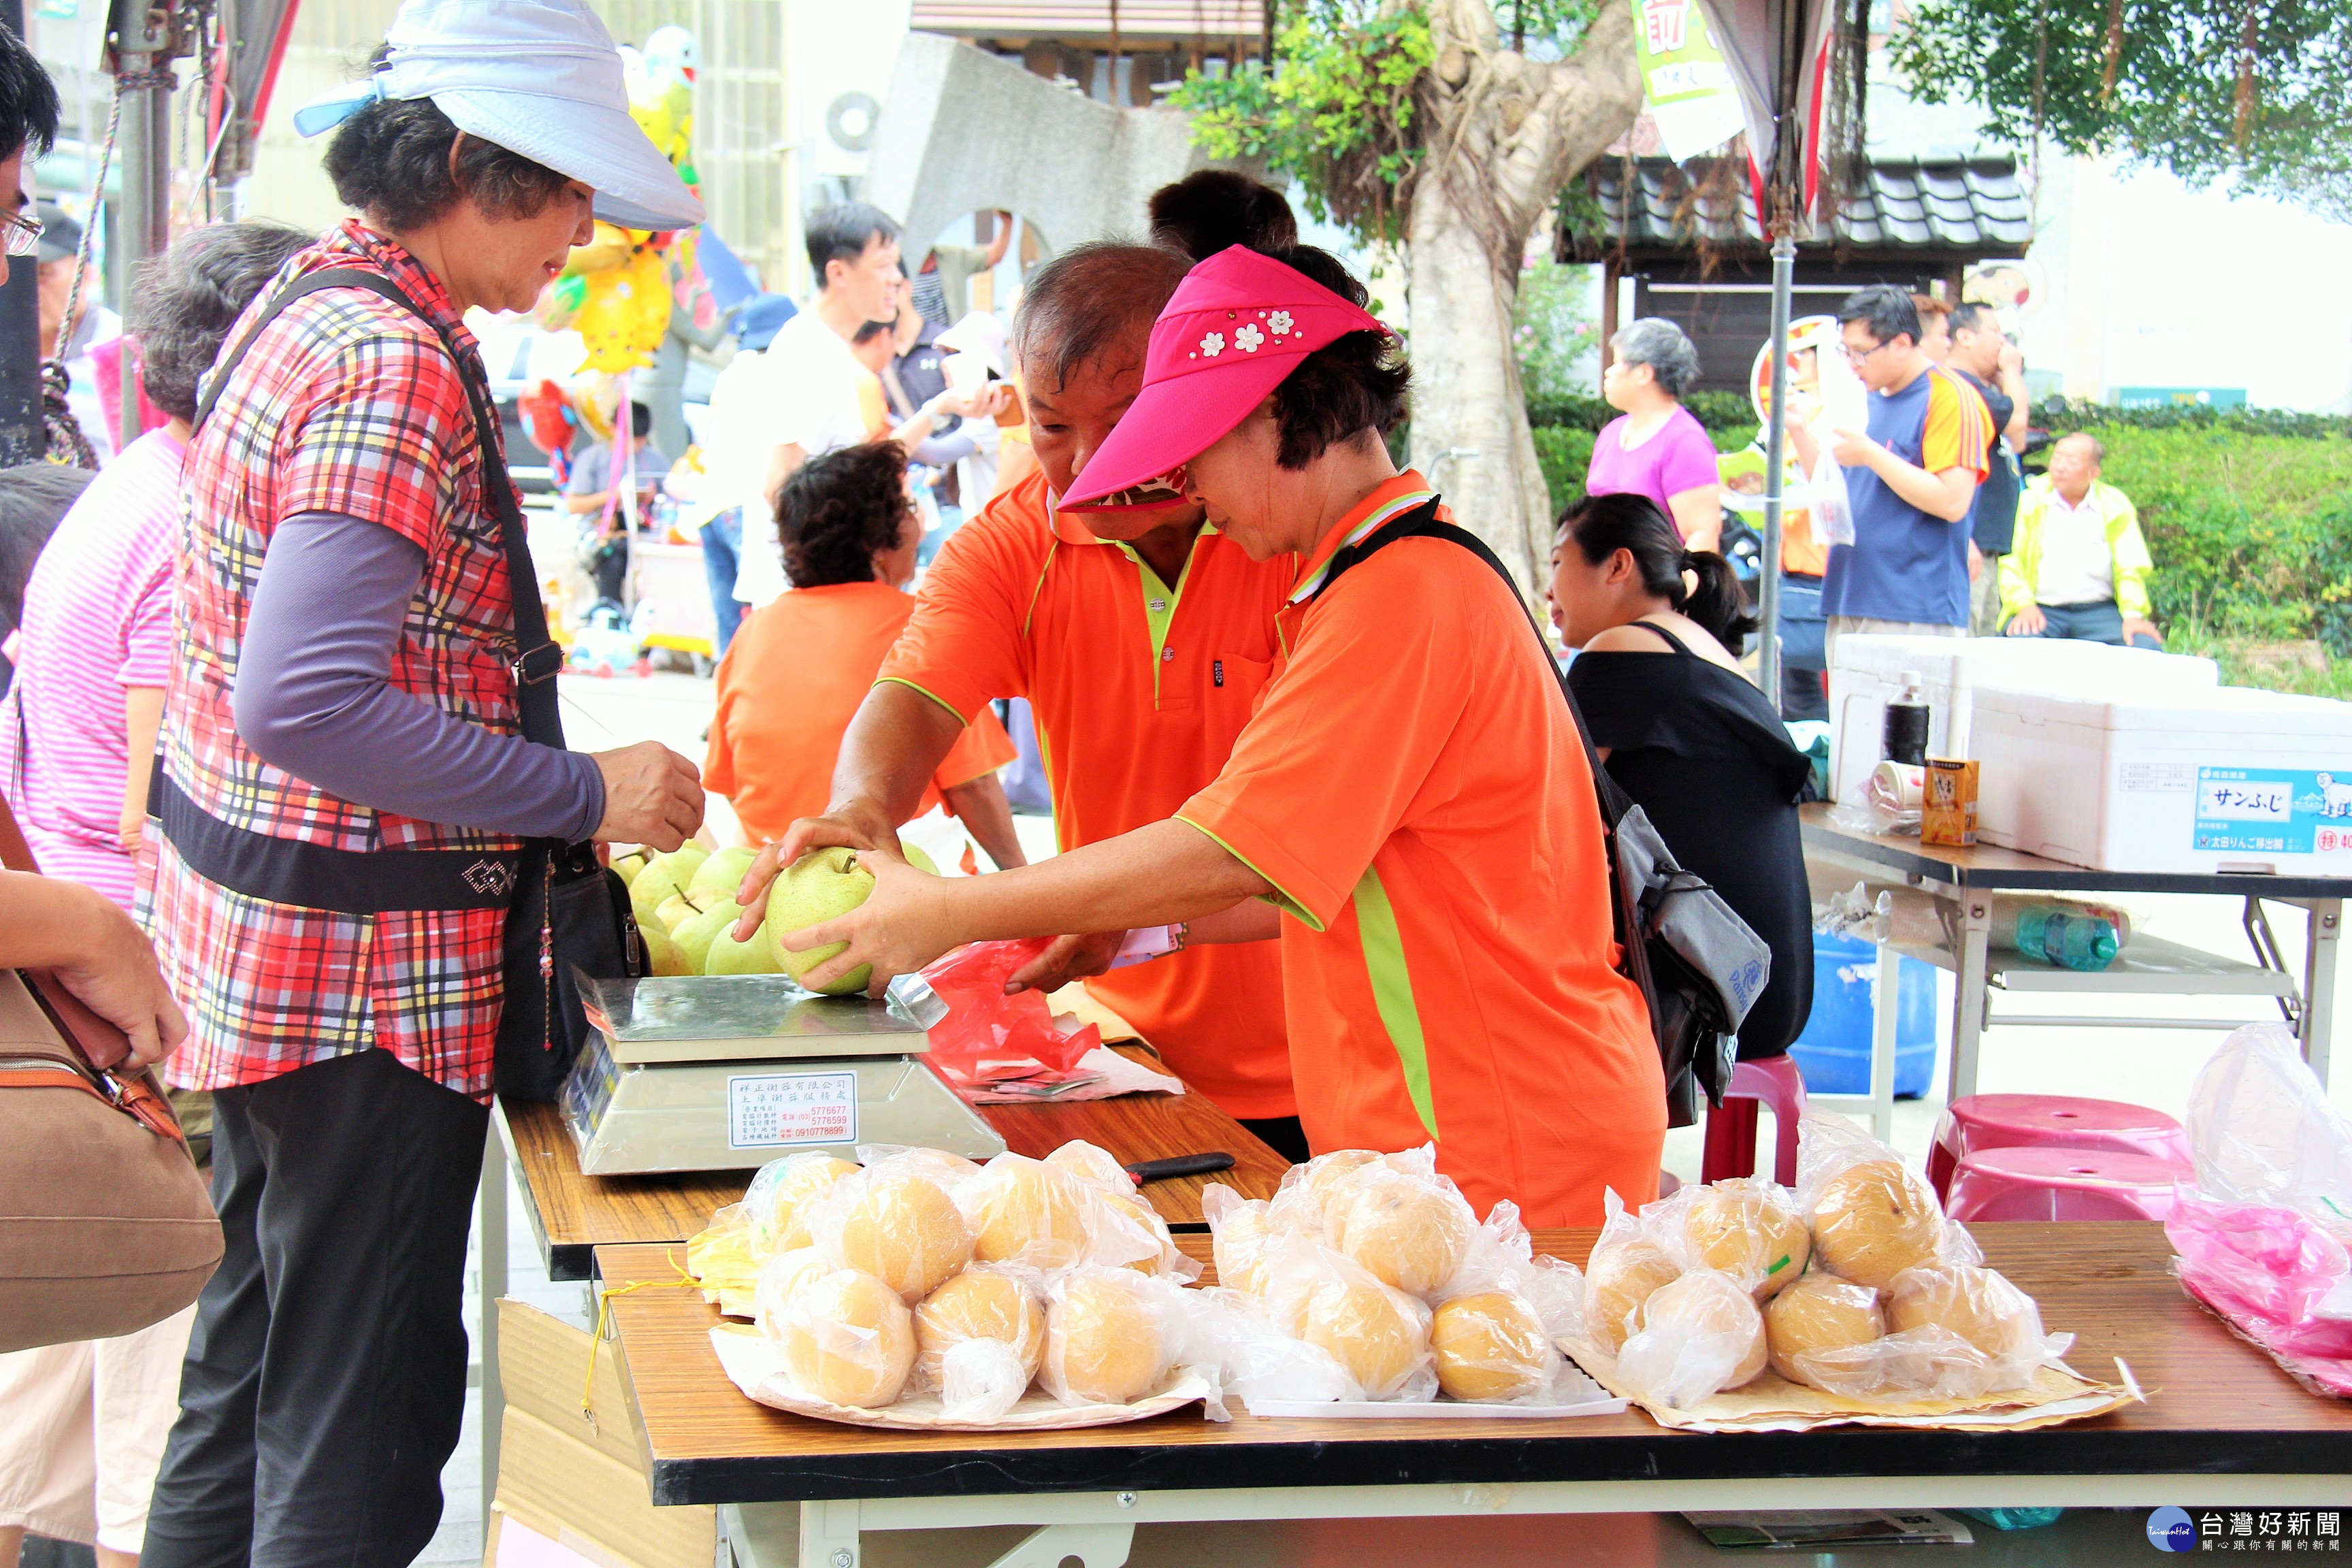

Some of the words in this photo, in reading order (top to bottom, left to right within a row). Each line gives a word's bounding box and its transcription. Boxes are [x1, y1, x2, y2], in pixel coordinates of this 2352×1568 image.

[2215, 789, 2283, 813] サンふじ
[811, 1106, 846, 1115] 5776677
[811, 1116, 847, 1125] 5776599
